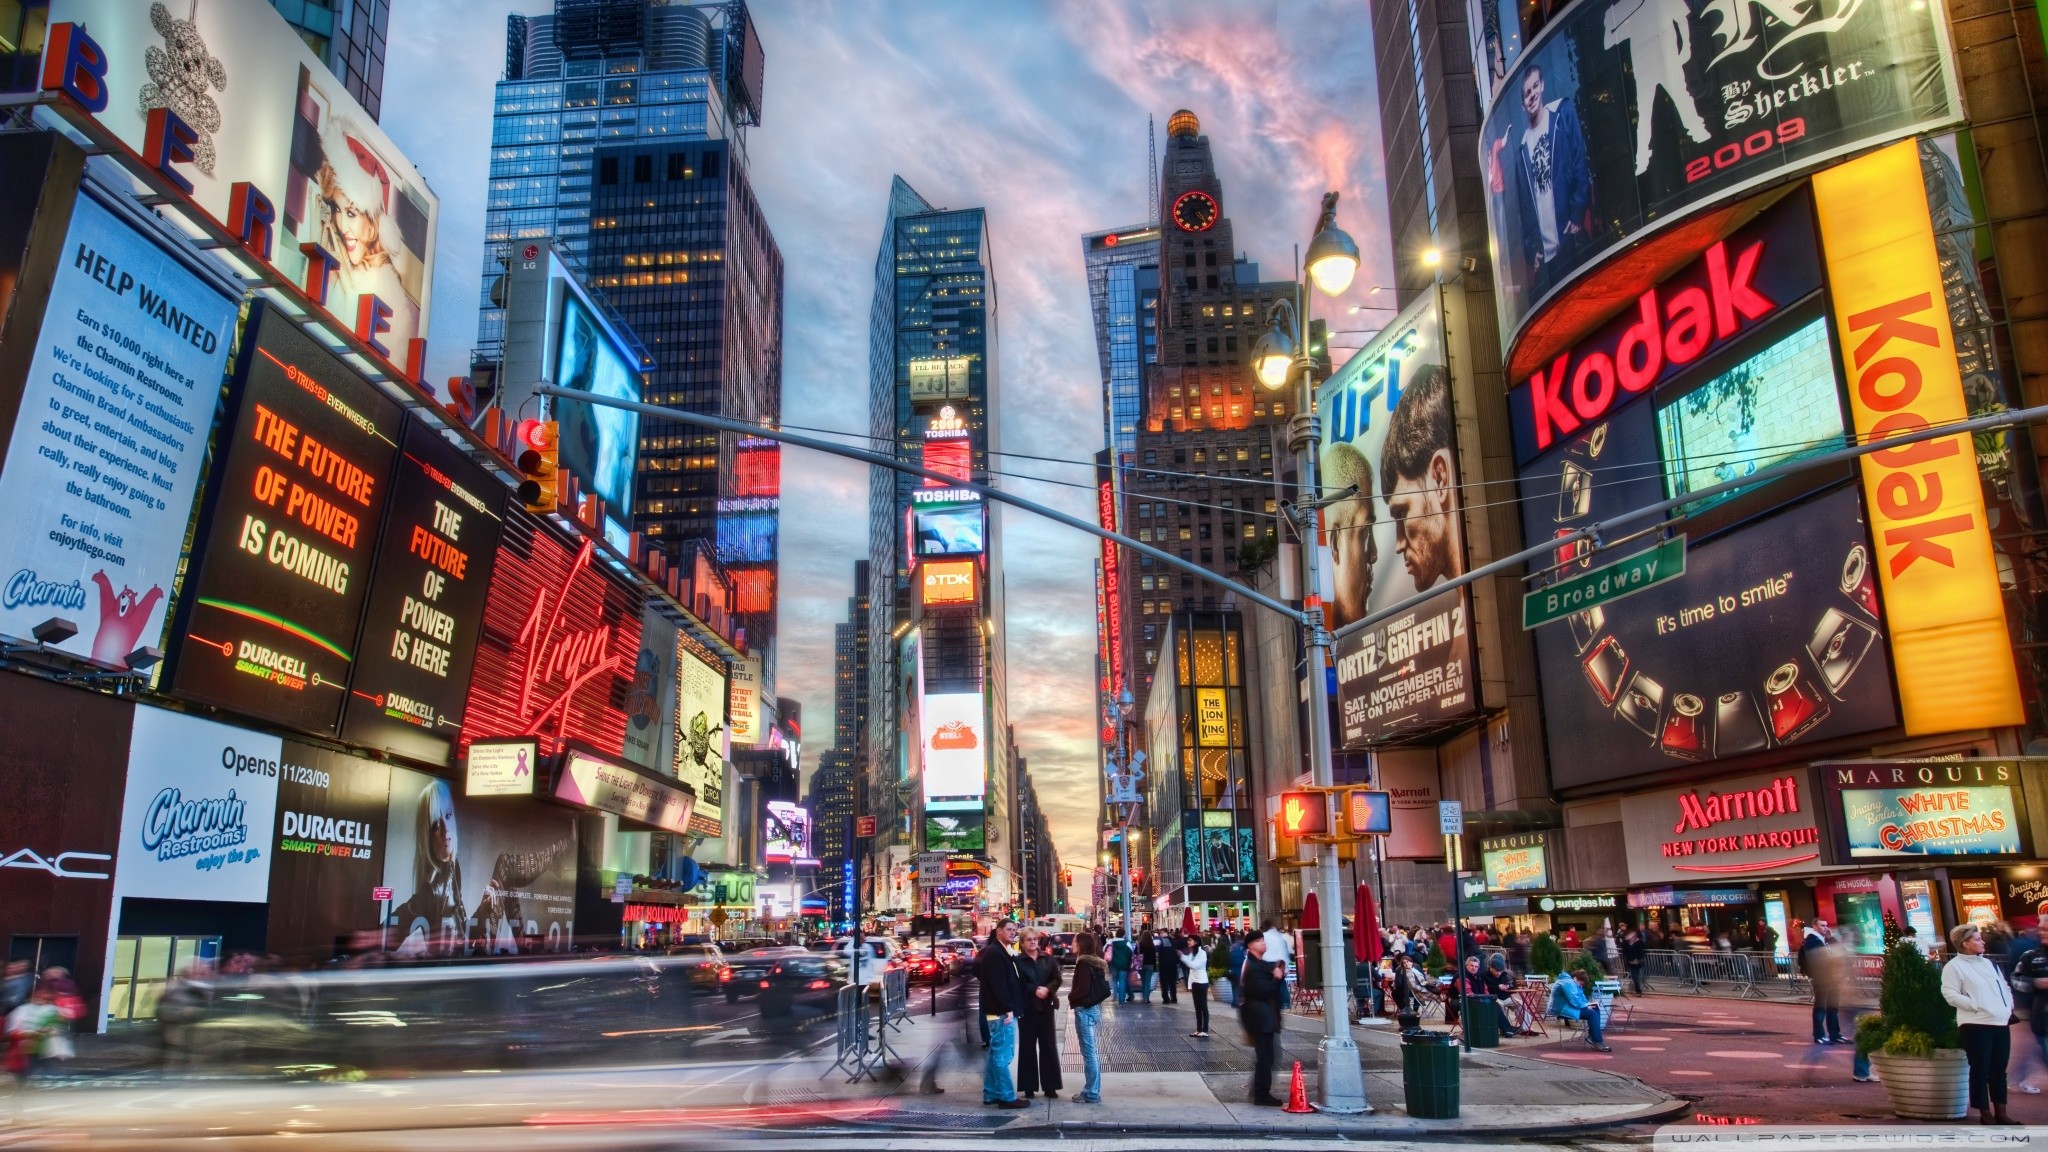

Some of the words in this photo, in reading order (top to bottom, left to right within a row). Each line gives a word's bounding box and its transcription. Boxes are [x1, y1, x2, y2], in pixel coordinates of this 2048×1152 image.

[1721, 78, 1751, 102] By
[1685, 116, 1806, 184] 2009
[74, 243, 134, 296] HELP
[138, 283, 217, 354] WANTED
[77, 308, 100, 332] Earn
[102, 322, 141, 356] $10,000
[141, 351, 163, 372] right
[164, 362, 184, 384] here
[184, 377, 195, 391] at
[1530, 239, 1777, 452] Kodak
[77, 335, 93, 352] the
[95, 346, 135, 377] Charmin
[136, 370, 184, 407] Restrooms.
[931, 363, 941, 371] BE
[52, 346, 81, 372] We're
[83, 362, 119, 395] looking
[121, 383, 136, 401] for
[137, 394, 144, 405] 5
[145, 402, 195, 435] enthusiastic
[1330, 328, 1417, 445] UFC
[52, 371, 95, 404] Charmin
[97, 395, 126, 421] Brand
[127, 413, 185, 453] Ambassadors
[326, 393, 369, 431] EVERYWHERE
[931, 419, 963, 430] 2009
[49, 397, 60, 411] to
[62, 404, 91, 430] greet,
[94, 421, 138, 453] entertain,
[140, 443, 157, 462] and
[158, 451, 178, 474] blog
[925, 429, 968, 438] TOSHIBA
[1847, 291, 1975, 581] Kodak
[42, 419, 72, 443] about
[73, 433, 98, 454] their
[99, 447, 150, 481] experience.
[152, 472, 173, 493] Must
[254, 404, 299, 460] THE
[298, 434, 375, 507] FUTURE
[38, 443, 71, 469] really,
[72, 460, 101, 483] really
[102, 473, 129, 496] enjoy
[128, 486, 154, 510] going
[155, 498, 166, 511] to
[66, 480, 83, 497] the
[84, 487, 132, 519] bathroom.
[253, 465, 288, 507] OF
[286, 483, 359, 549] POWER
[451, 481, 481, 511] EVERYWHERE
[913, 489, 981, 503] TOSHIBA
[60, 513, 78, 530] For
[79, 520, 101, 542] info,
[103, 532, 124, 549] visit
[433, 499, 462, 541] THE
[1100, 481, 1116, 570] Macovision
[49, 530, 125, 567] enjoythego.com
[239, 514, 267, 556] IS
[268, 530, 349, 595] COMING
[410, 525, 469, 581] FUTURE
[3, 568, 86, 610] Charmin
[423, 570, 445, 602] OF
[935, 573, 971, 585] TDK
[1106, 572, 1118, 593] for
[1546, 557, 1659, 615] Broadway
[401, 595, 455, 645] POWER
[1107, 592, 1120, 633] name
[1387, 613, 1416, 634] FORREST
[1656, 614, 1676, 636] it's
[1679, 602, 1715, 628] time
[1718, 594, 1736, 615] to
[391, 629, 410, 661] IS
[410, 640, 451, 678] HERE
[519, 539, 620, 752] Virgin
[1112, 634, 1122, 669] new
[1362, 632, 1375, 647] TITO
[1387, 612, 1451, 665] GRIFFIN
[1452, 607, 1465, 638] 2
[238, 640, 308, 680] DURACELL
[1337, 645, 1378, 684] ORTIZ
[1203, 699, 1220, 707] THE
[1344, 696, 1369, 715] SAT.
[1370, 667, 1443, 705] NOVEMBER
[1446, 659, 1463, 678] 21
[1345, 712, 1366, 727] LIVE
[1367, 706, 1383, 720] ON
[1385, 675, 1464, 714] PAY-PER-VIEW
[386, 692, 434, 721] DURACELL
[1201, 709, 1223, 723] LION
[1202, 725, 1225, 738] KING
[221, 746, 277, 777] Opens
[282, 763, 330, 789] 11/23/09
[1837, 766, 2010, 784] MARQUIS
[1929, 753, 1964, 763] CHANNEL
[704, 787, 720, 801] CIRCA
[1390, 787, 1430, 798] Marriott
[1674, 775, 1799, 834] Marriott
[1850, 800, 1883, 820] Irving
[1897, 790, 1970, 816] WHITE
[142, 787, 247, 851] Charmin
[282, 811, 373, 847] DURACELL
[1865, 806, 1905, 827] Berlin's
[1879, 809, 2007, 851] CHRISTMAS
[157, 824, 248, 862] Restrooms!
[352, 848, 371, 860] LAB
[934, 855, 946, 863] LANE
[1483, 833, 1544, 850] MARQUIS
[1503, 850, 1528, 865] WHITE
[1661, 840, 1694, 858] NEW
[1696, 835, 1738, 854] YORK
[1949, 837, 1982, 845] MUSICAL
[196, 852, 225, 872] enjoy
[227, 849, 244, 864] the
[924, 866, 940, 874] MUST
[1497, 862, 1541, 887] CHRISTMAS
[932, 876, 946, 884] RIGHT
[1728, 893, 1756, 901] OFFICE
[1835, 880, 1847, 888] THE
[1847, 879, 1873, 888] MUSICAL
[2008, 880, 2042, 898] Irving
[646, 906, 690, 924] HOLLYWOOD
[1556, 897, 1598, 911] sunglass
[1598, 896, 1617, 908] hut
